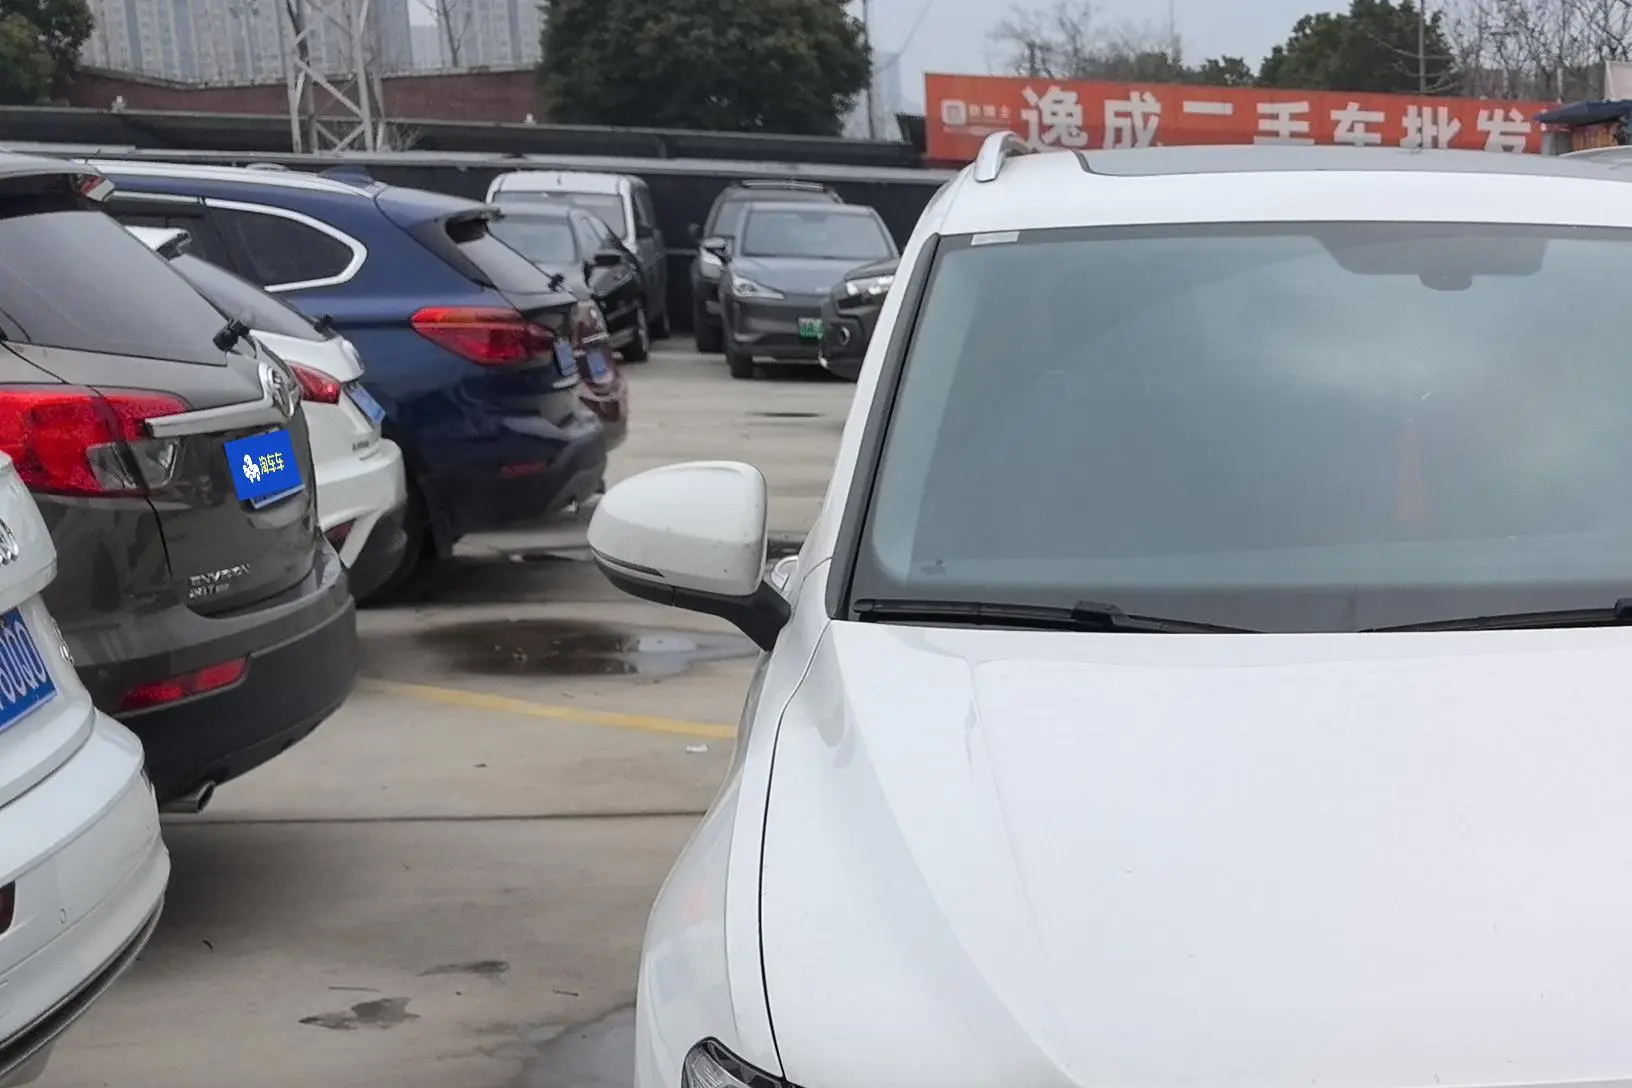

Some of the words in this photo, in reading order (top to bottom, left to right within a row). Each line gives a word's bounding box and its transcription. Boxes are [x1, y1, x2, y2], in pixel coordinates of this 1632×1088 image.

[1020, 84, 1548, 153] 逸成二手车批发
